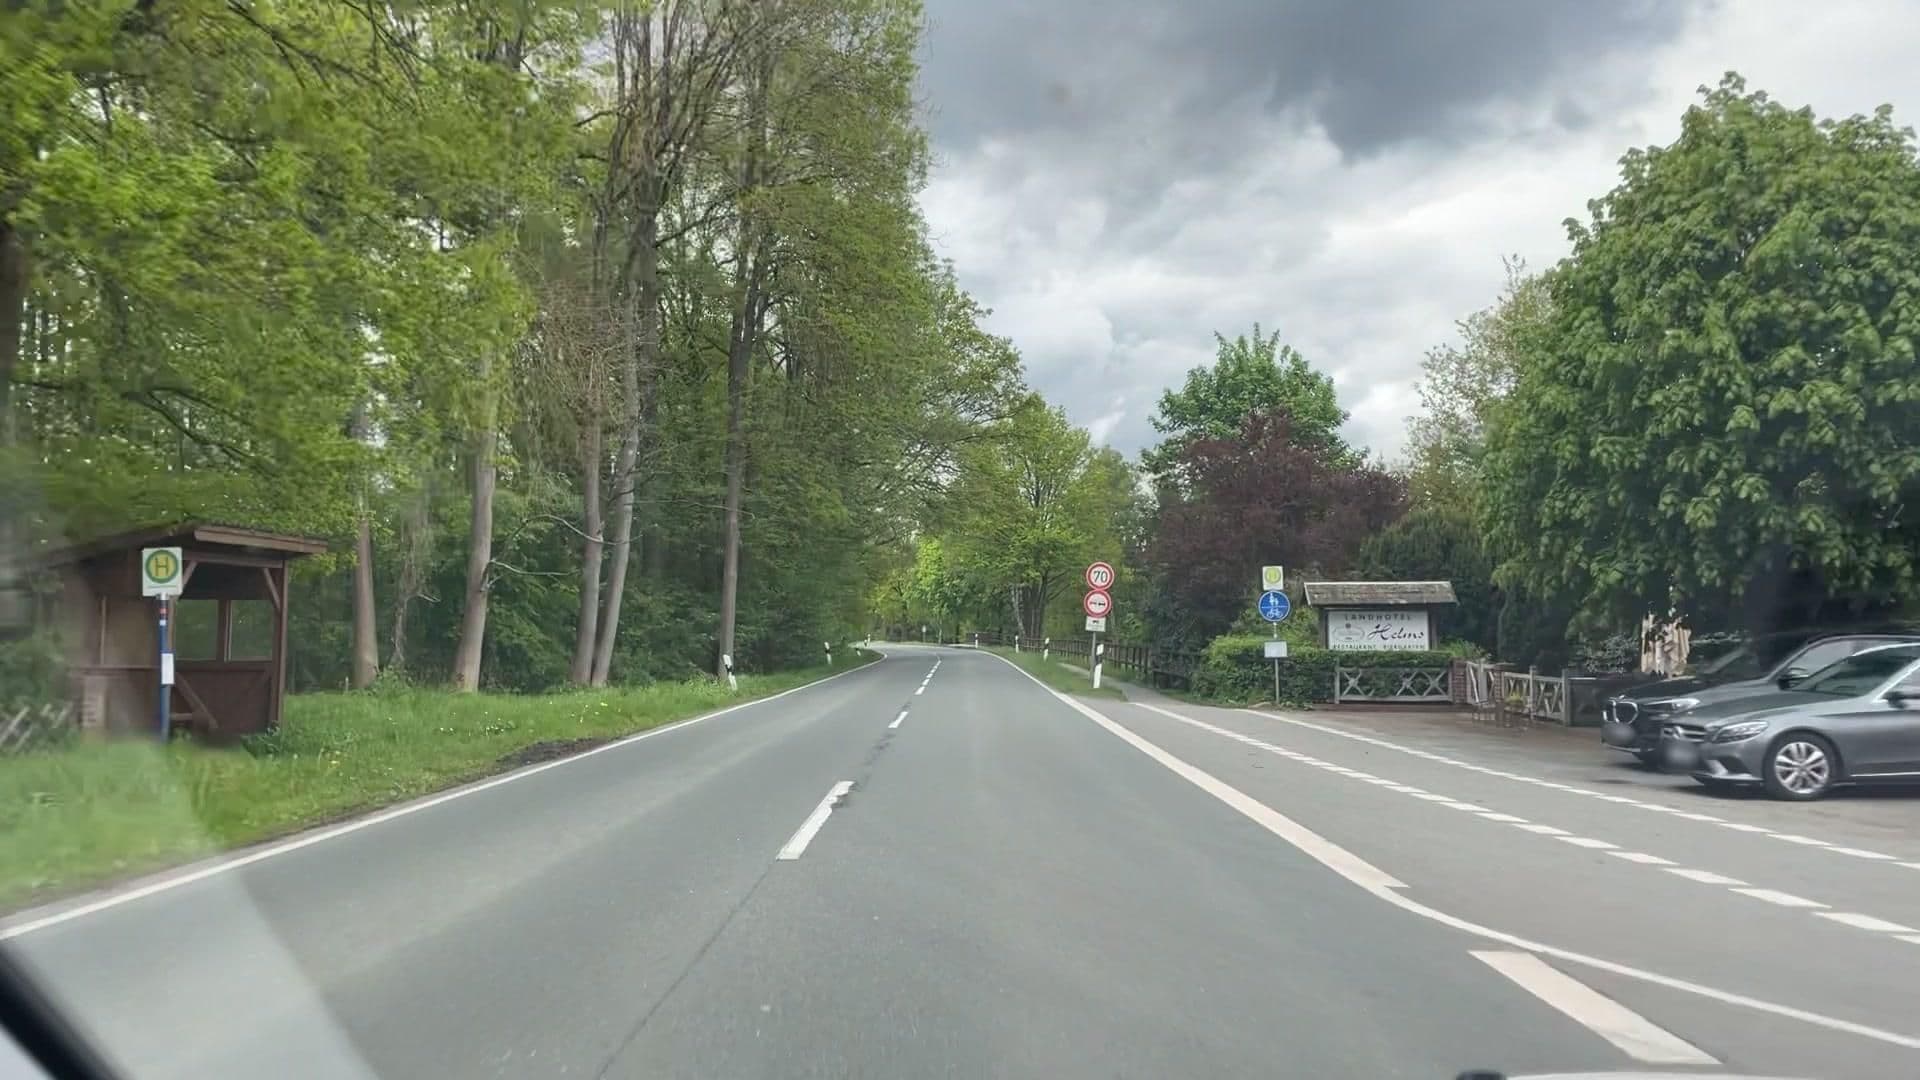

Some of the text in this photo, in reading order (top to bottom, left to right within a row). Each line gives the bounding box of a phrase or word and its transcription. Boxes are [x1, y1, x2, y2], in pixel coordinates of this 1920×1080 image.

[155, 556, 168, 576] H
[1094, 570, 1108, 582] 70
[1344, 613, 1411, 621] LANDHOTEL
